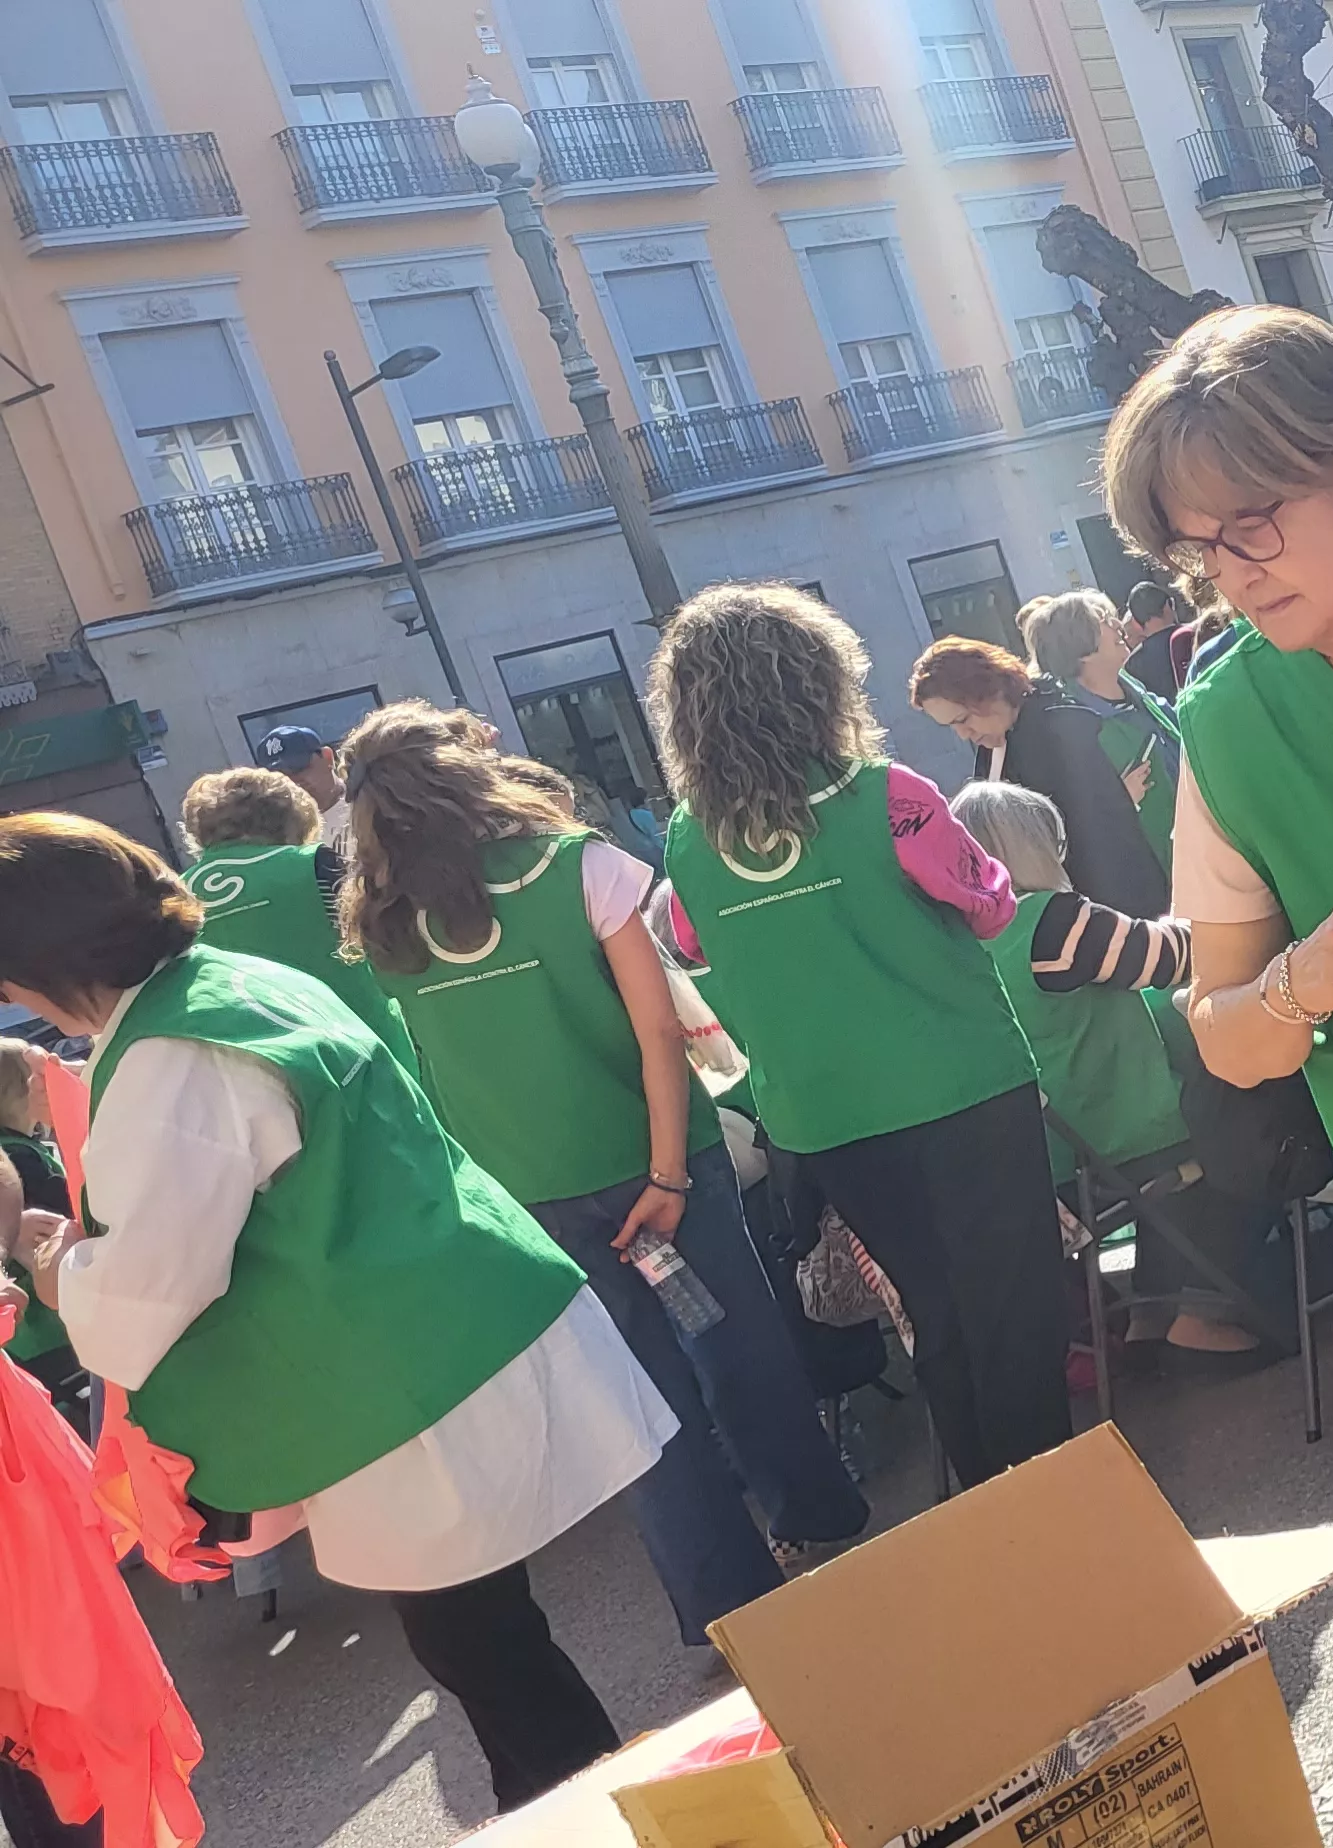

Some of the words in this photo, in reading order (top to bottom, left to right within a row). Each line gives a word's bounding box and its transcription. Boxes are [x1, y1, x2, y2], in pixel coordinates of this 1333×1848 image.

[752, 893, 784, 907] ESPAÑOLA
[815, 877, 842, 891] CÁNCER
[1038, 1777, 1102, 1829] ROLY
[1093, 1790, 1128, 1834] (02)
[1136, 1760, 1183, 1798] BAHRAIN
[1147, 1802, 1166, 1820] CA
[1166, 1782, 1193, 1808] 0407
